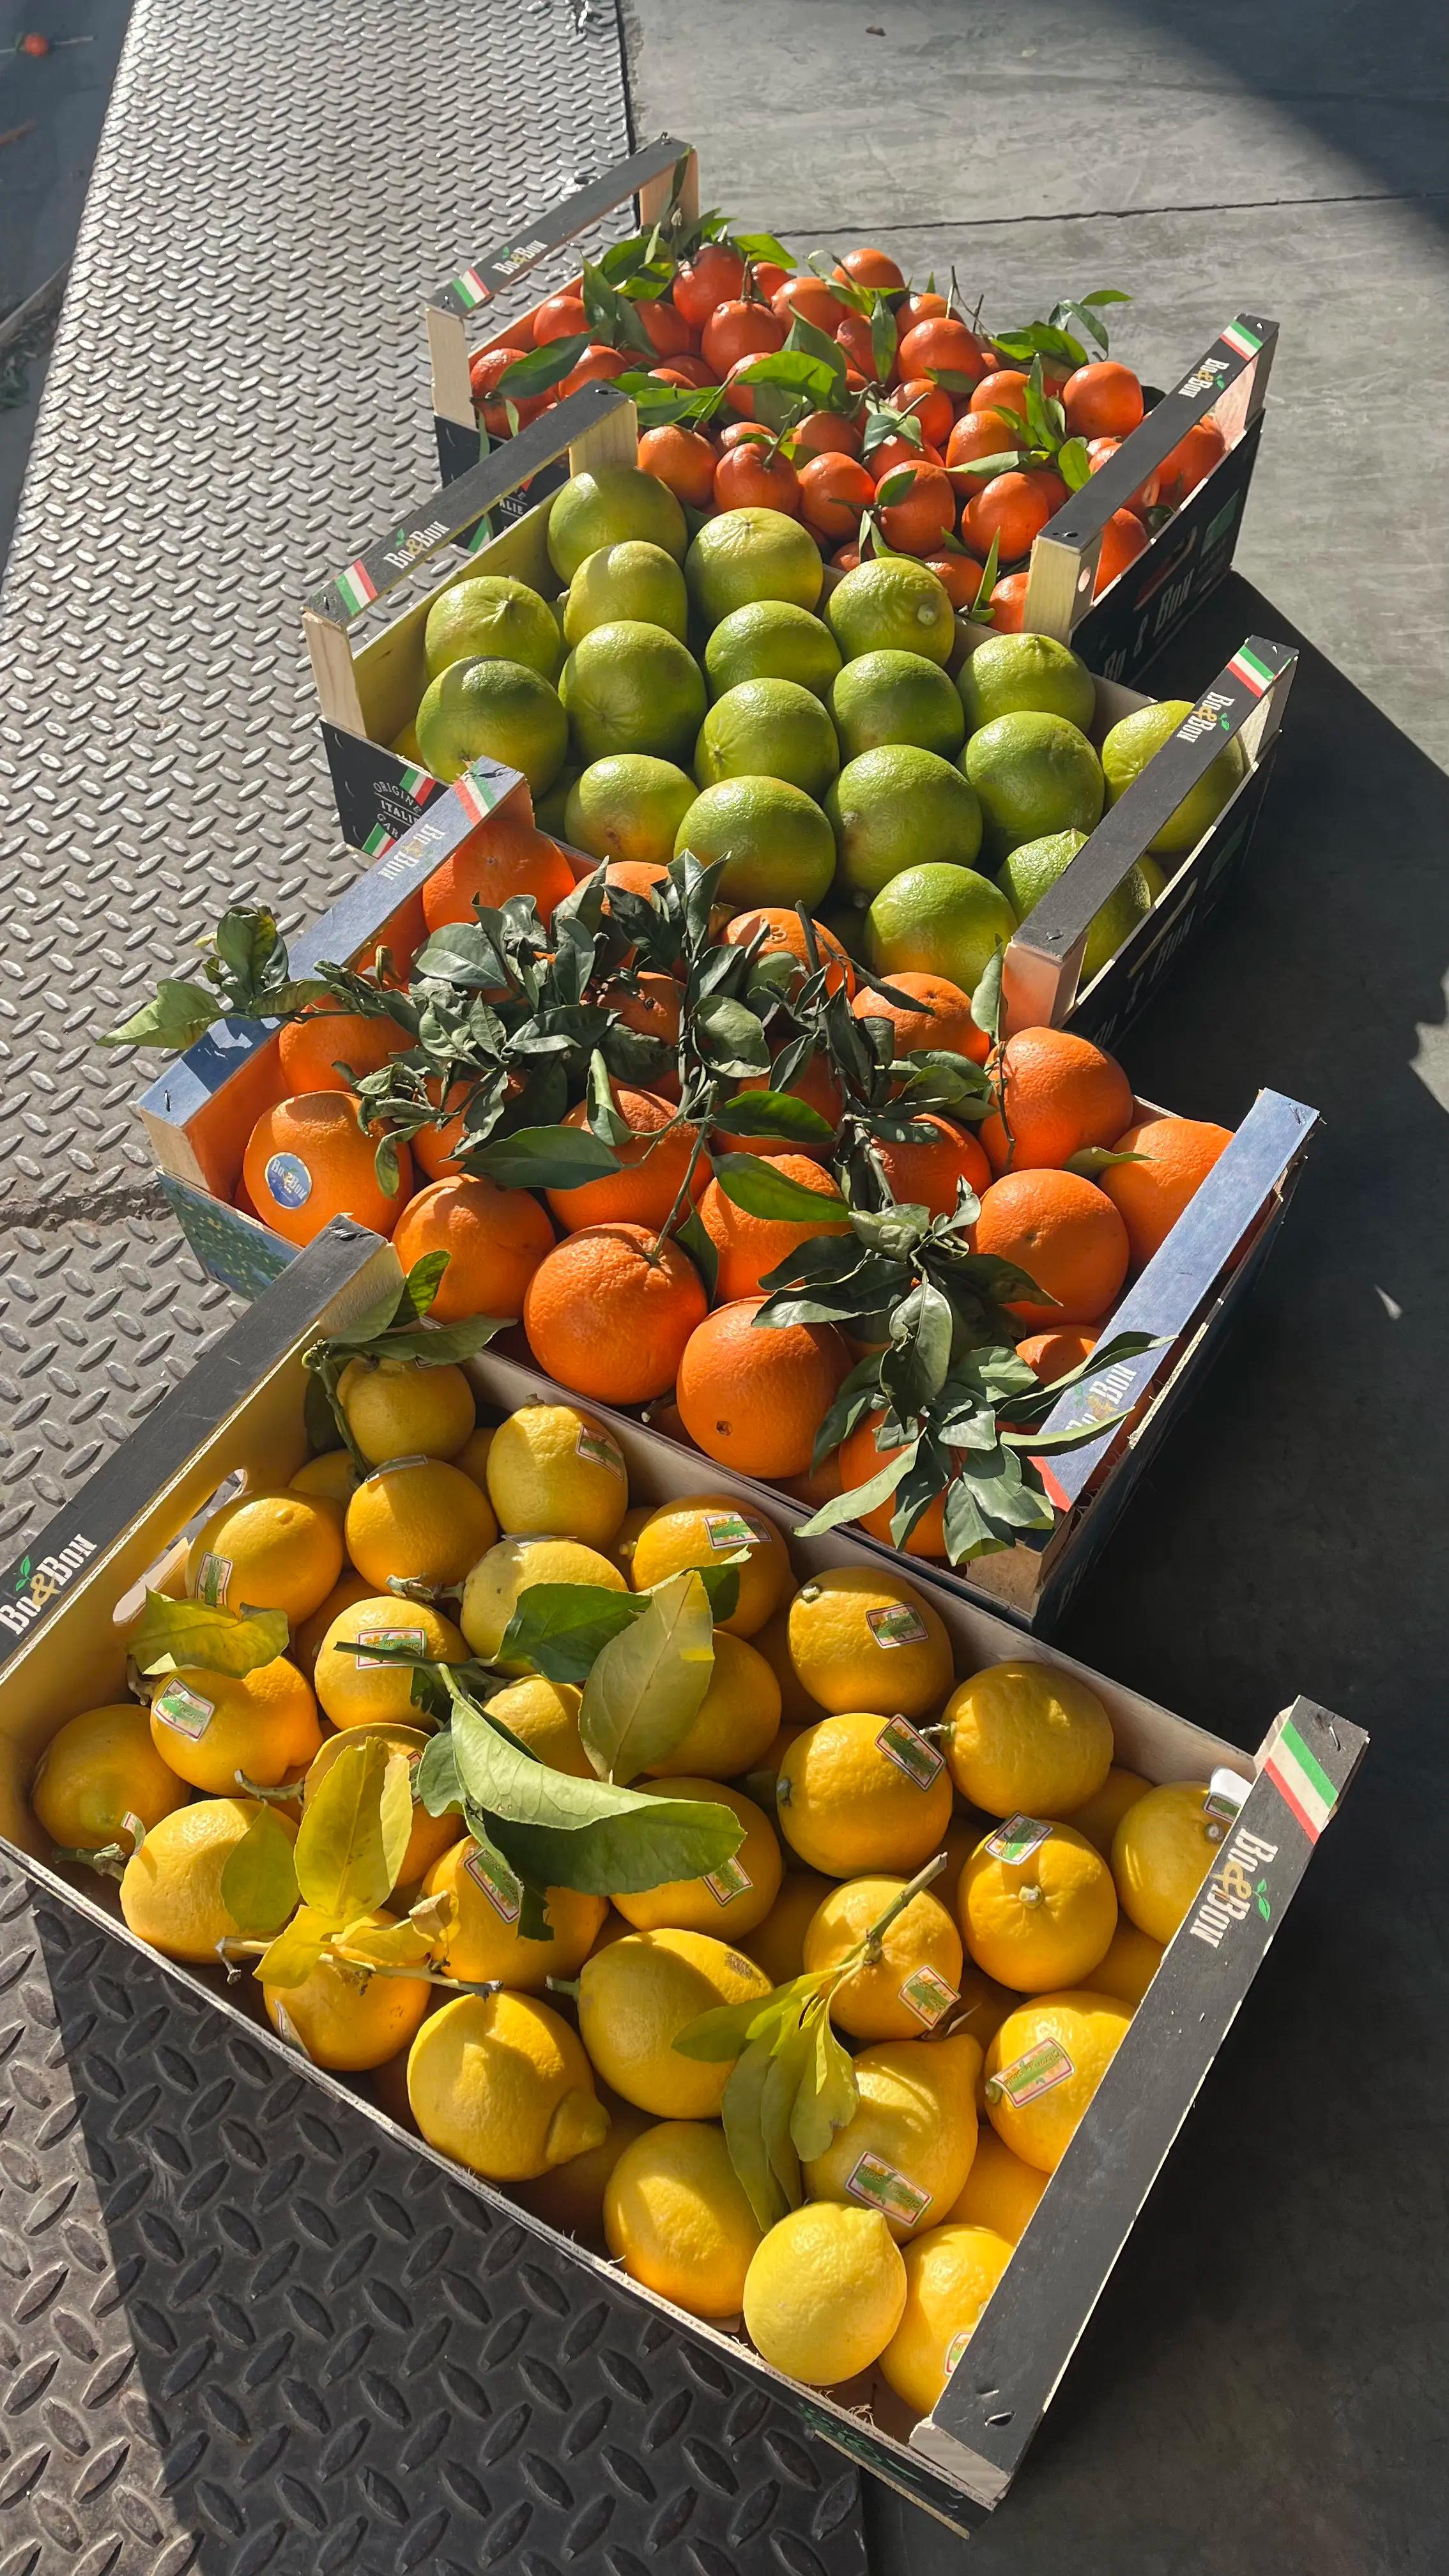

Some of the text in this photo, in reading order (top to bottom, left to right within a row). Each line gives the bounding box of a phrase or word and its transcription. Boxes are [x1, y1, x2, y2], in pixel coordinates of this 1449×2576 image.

[500, 497, 523, 514] ALIE
[373, 781, 422, 813] ORIGINE
[859, 2165, 884, 2184] Sicile
[894, 2190, 921, 2210] Citron
